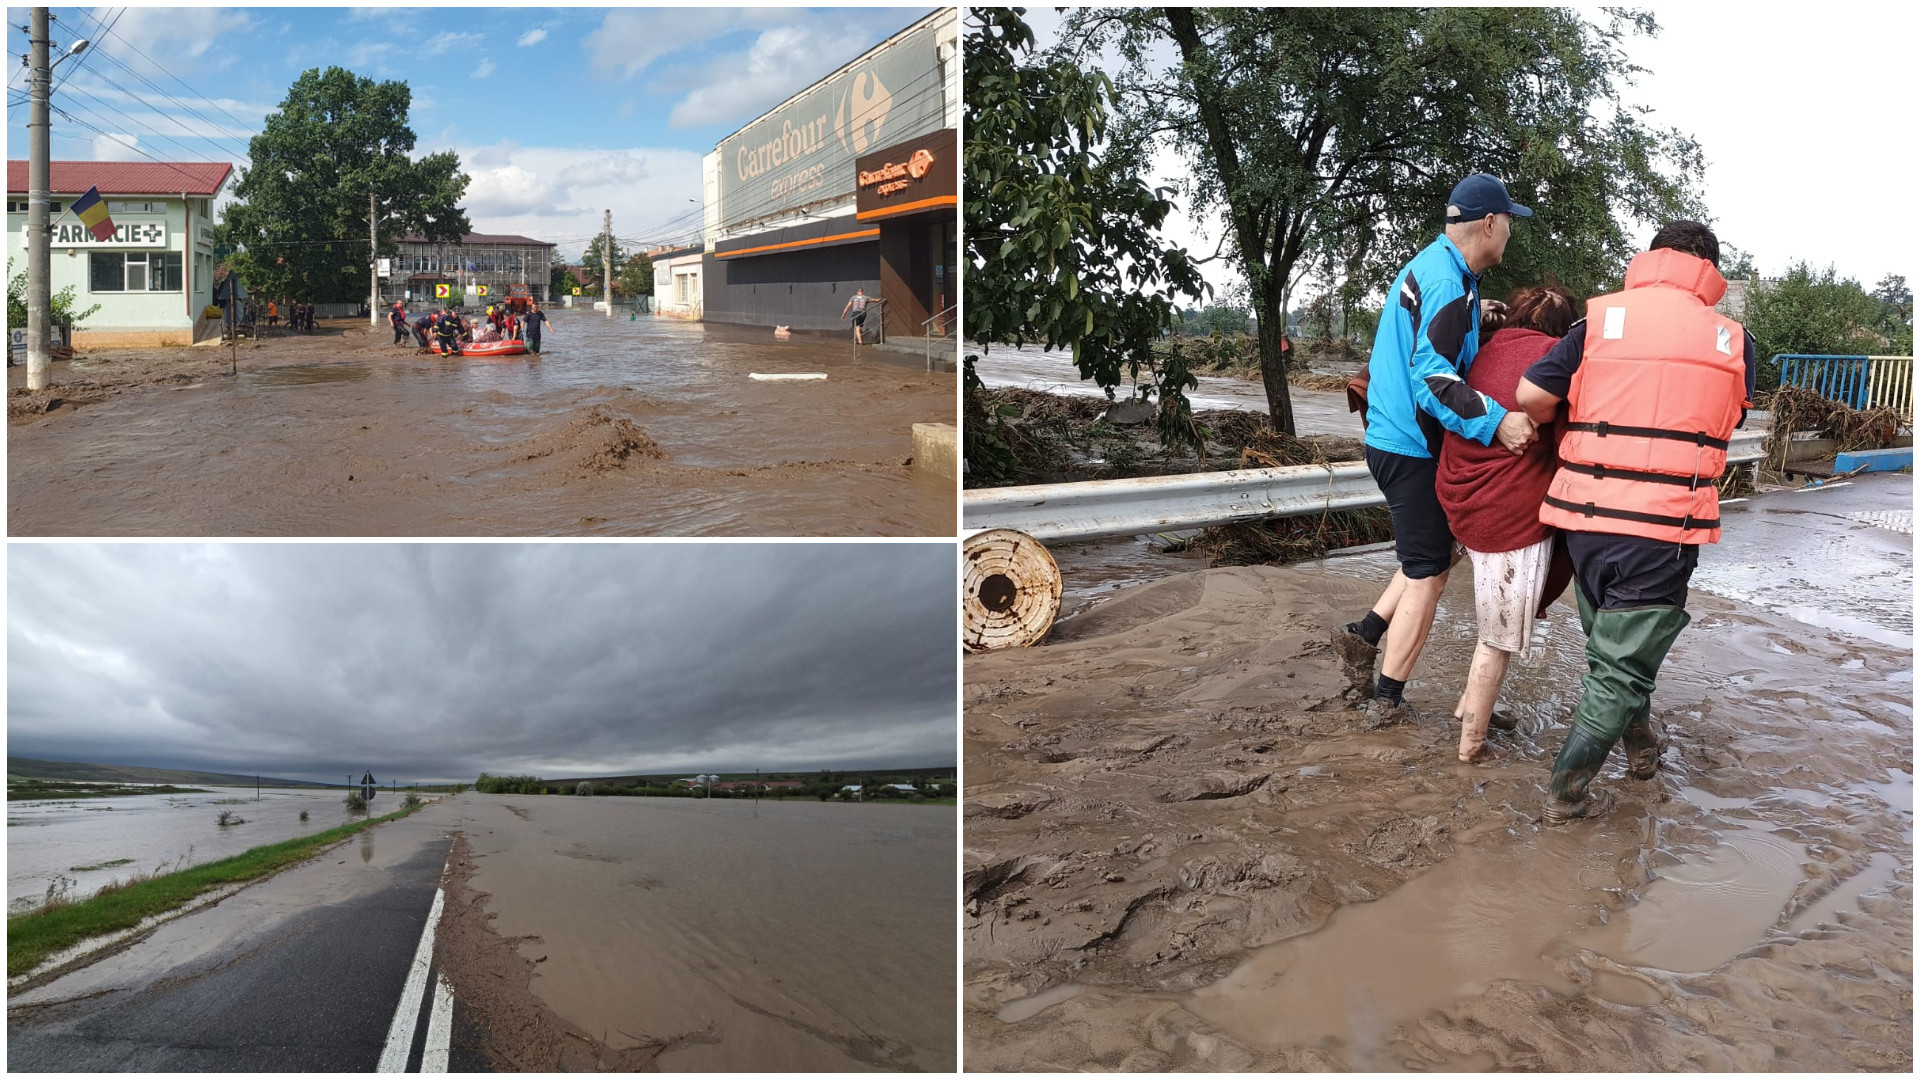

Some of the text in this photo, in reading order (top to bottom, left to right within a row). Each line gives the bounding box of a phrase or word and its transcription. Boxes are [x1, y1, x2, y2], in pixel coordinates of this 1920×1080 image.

[737, 113, 827, 182] Carrefour
[770, 162, 825, 204] express
[859, 162, 908, 187] Carrefour
[877, 179, 908, 196] express
[50, 224, 141, 243] FARCIE
